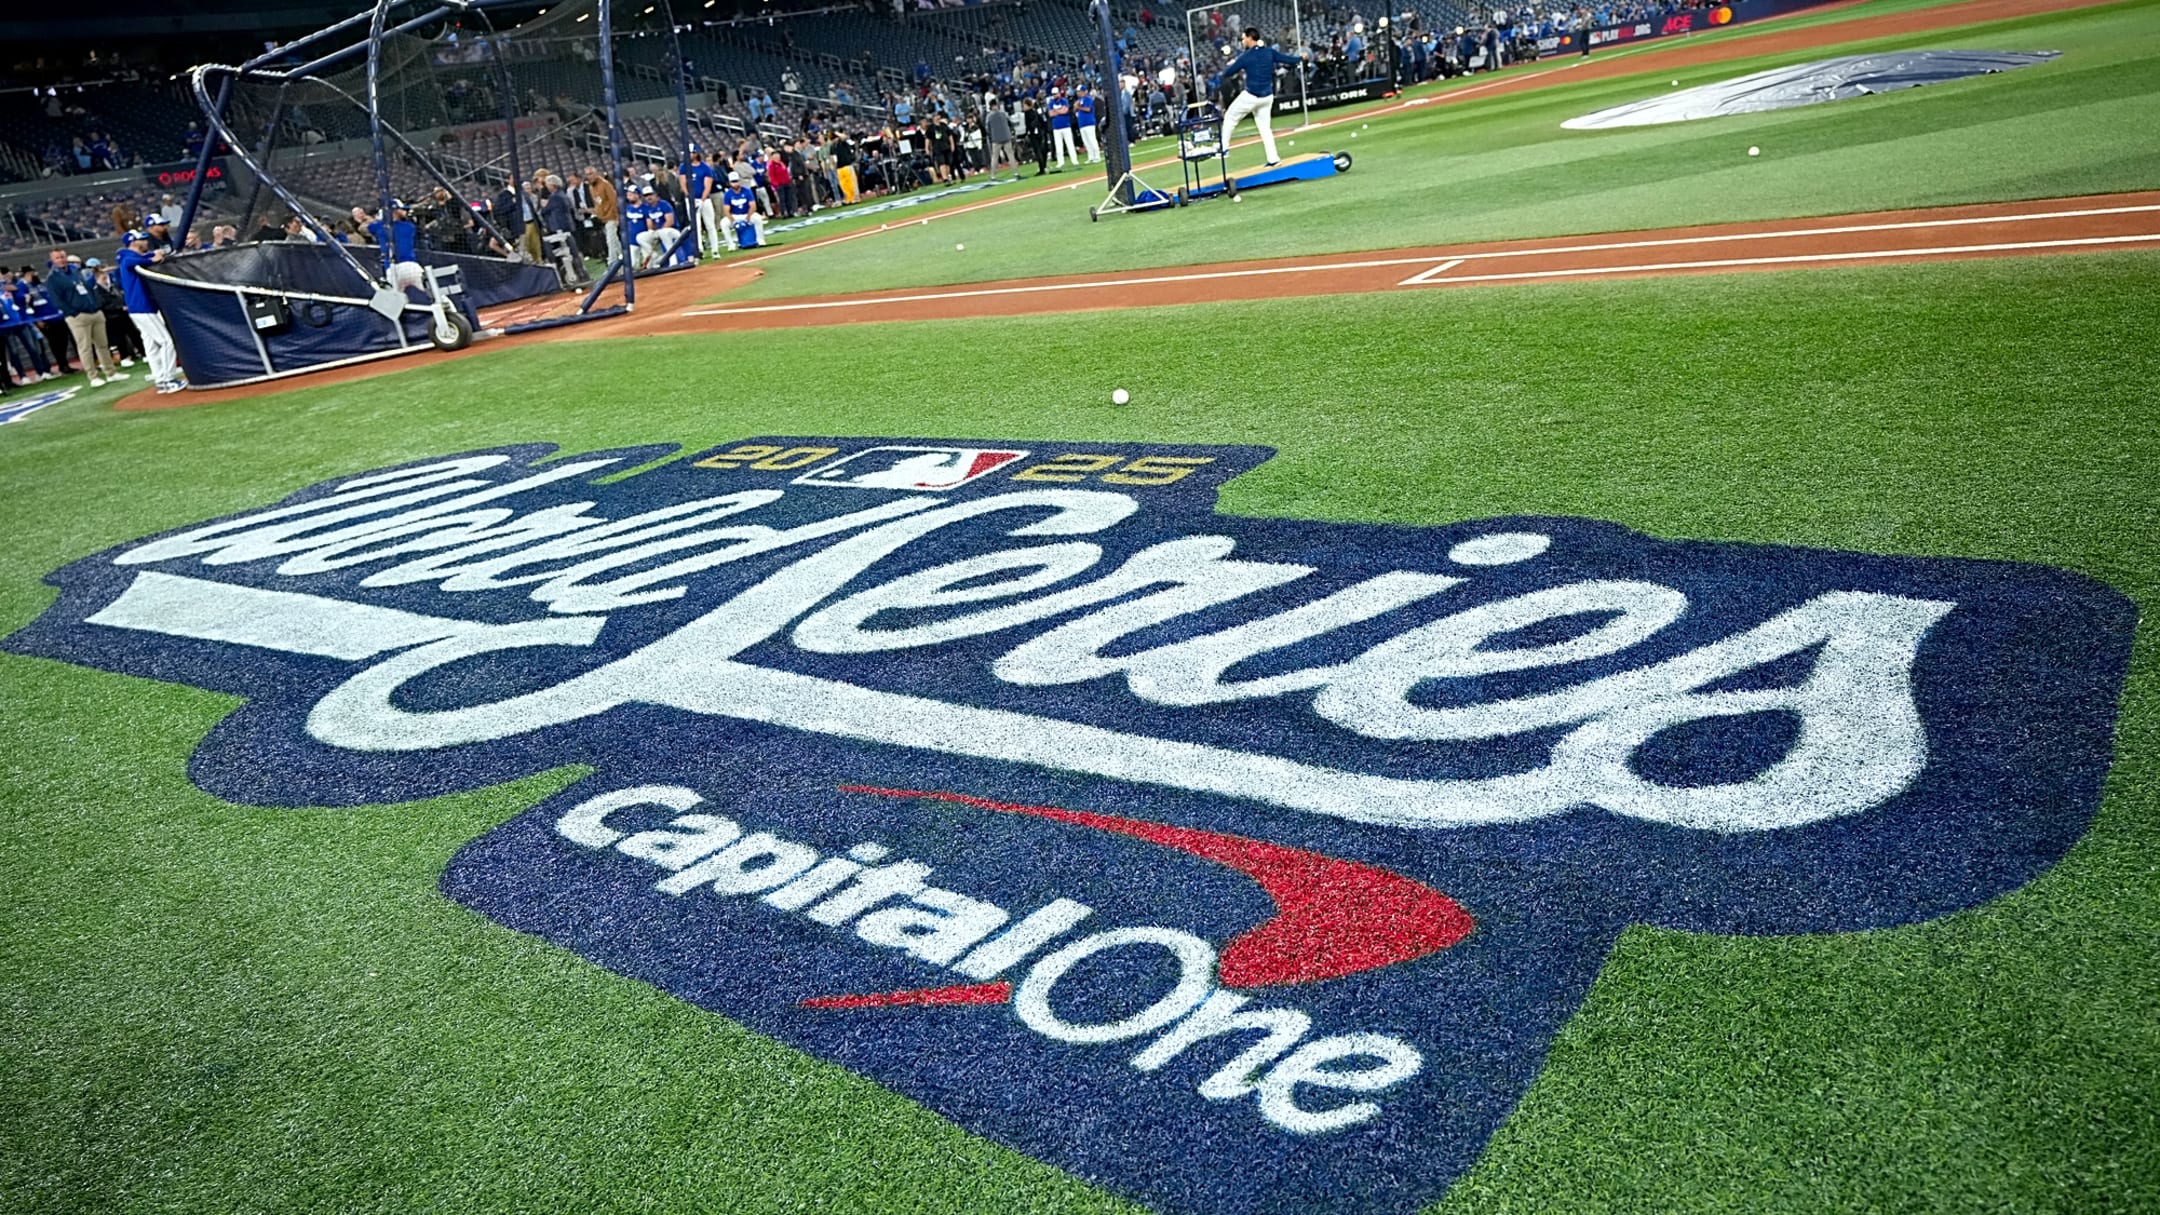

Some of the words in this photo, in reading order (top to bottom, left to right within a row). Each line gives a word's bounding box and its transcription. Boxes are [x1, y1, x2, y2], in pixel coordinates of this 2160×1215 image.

[1662, 15, 1692, 33] ACE
[1279, 101, 1299, 111] MLB
[1304, 89, 1368, 106] NWORK
[174, 167, 221, 181] ROGRS
[692, 446, 840, 470] 20
[1009, 453, 1214, 485] 25
[113, 454, 945, 614] World
[306, 490, 1956, 833] Series
